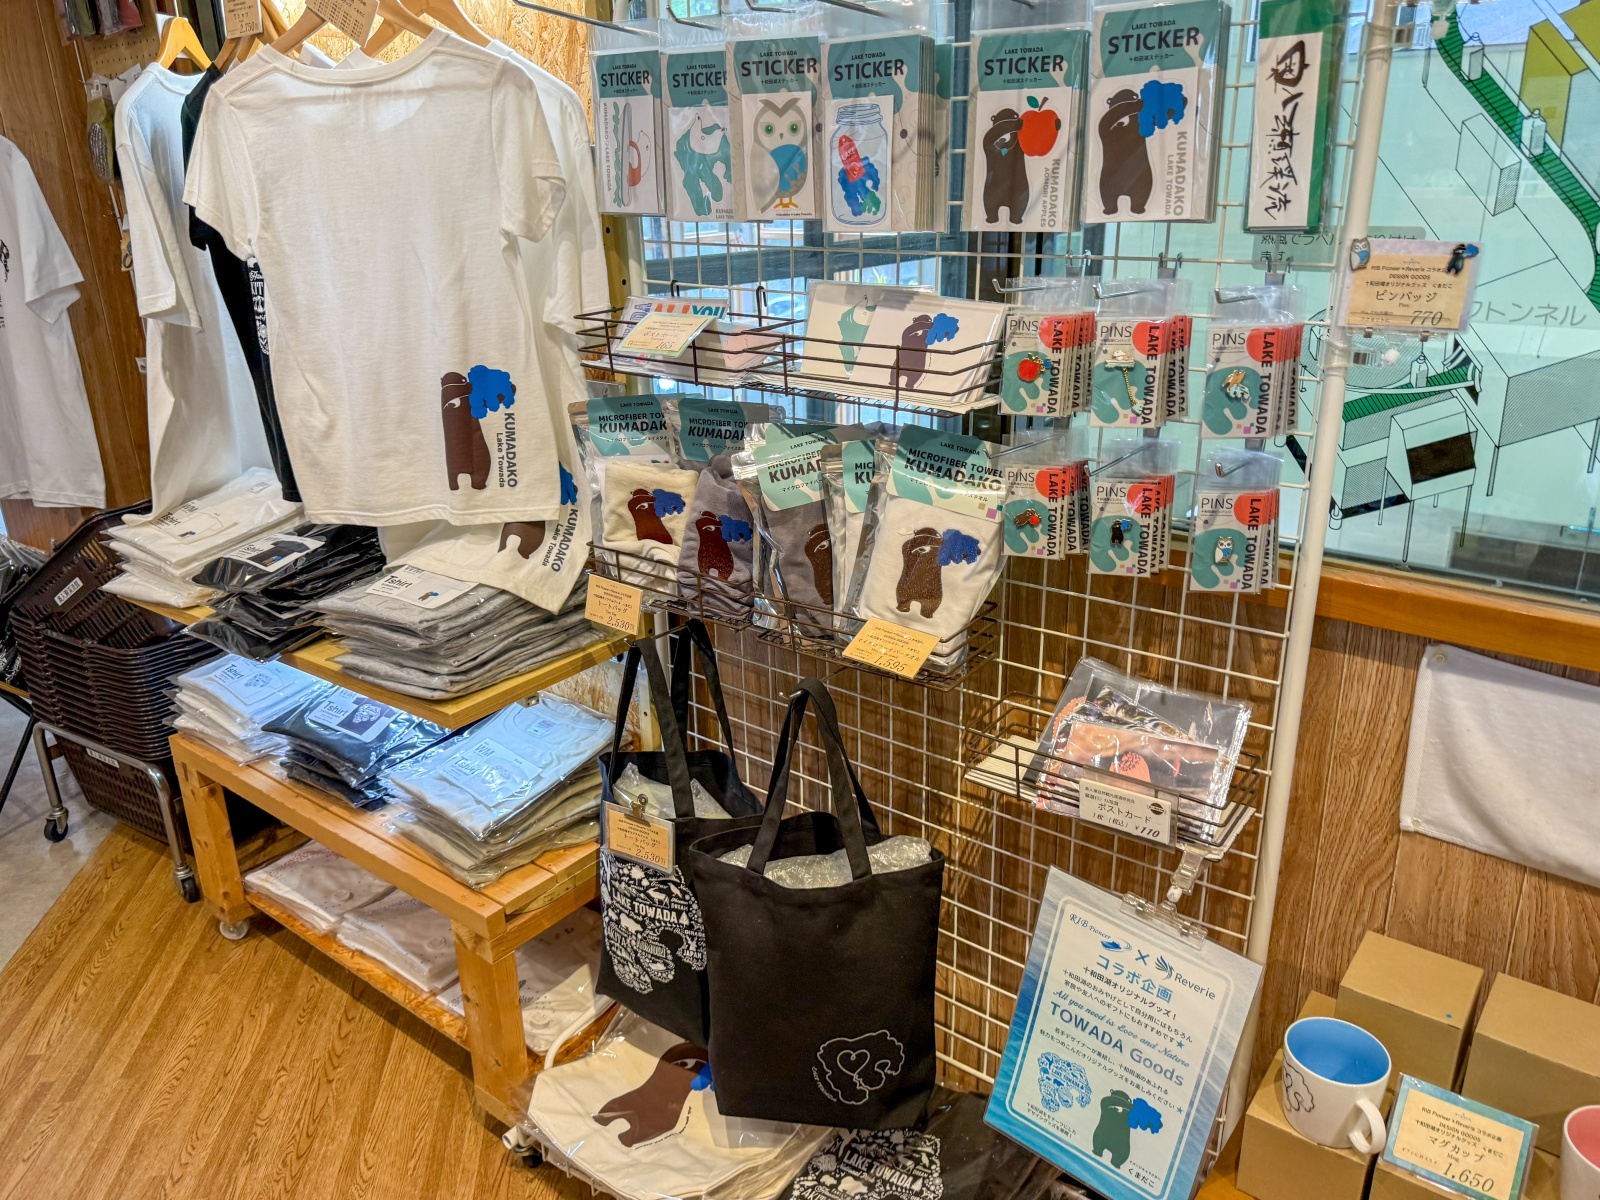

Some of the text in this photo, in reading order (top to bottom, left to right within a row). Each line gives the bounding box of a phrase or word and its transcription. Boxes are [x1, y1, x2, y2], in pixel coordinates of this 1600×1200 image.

[1132, 20, 1176, 30] LAKE TOWADA
[1108, 27, 1200, 54] STICKER
[741, 58, 817, 77] STICKER
[834, 59, 904, 82] STICKER
[984, 54, 1064, 76] STICKER
[601, 70, 650, 87] STICKER
[1173, 131, 1187, 216] KUMADAKO
[1049, 158, 1060, 228] KUMADAKO
[1164, 178, 1172, 216] TOWADA
[1376, 290, 1437, 303] ピンバッジ
[1010, 320, 1039, 332] PINS
[1411, 311, 1443, 326] 770
[1100, 326, 1132, 338] PINS
[1213, 333, 1246, 345] PINS
[656, 342, 675, 350] 165
[1047, 321, 1064, 414] LAKE TOWADA
[1141, 326, 1160, 425] LAKE TOWADA
[1255, 332, 1275, 434] LAKE TOWADA
[599, 413, 647, 422] MICROFIBER
[689, 418, 732, 428] MICROFIBER
[504, 412, 518, 488] KUMADAKO
[790, 437, 828, 450] LAKE TOWADA
[956, 446, 980, 456] TOWADA
[908, 448, 1003, 478] MICROFIBER TOWEL
[905, 458, 1002, 491] KUMADAKO
[1008, 472, 1035, 482] PINS
[1097, 486, 1126, 497] PINS
[1201, 498, 1233, 510] PINS
[161, 512, 181, 525] Tshirt
[1047, 474, 1058, 557] LAKE TOWADA
[1068, 501, 1077, 551] TOWADA
[1080, 496, 1090, 550] TOWADA
[551, 509, 578, 573] KUMADAKO
[1137, 488, 1152, 575] LAKE TOWADA
[542, 524, 564, 567] Lake Towada
[1242, 499, 1261, 590] LAKE TOWADA
[385, 576, 413, 588] Tshirt
[225, 664, 244, 679] Tshirt
[324, 701, 348, 716] Tshirt
[455, 756, 480, 775] Tshirt
[1098, 803, 1152, 824] ポストカード
[1135, 824, 1160, 838] ¥110
[613, 888, 678, 923] LAKE TOWADA
[1089, 925, 1111, 940] Pioneer
[1096, 954, 1174, 1004] コラボ企画
[1175, 974, 1216, 1000] Reverie
[1053, 990, 1190, 1068] All you need is Love and Nature
[1050, 1001, 1184, 1086] TOWADA Goods
[1432, 1110, 1451, 1121] Pioneer
[1456, 1120, 1476, 1131] Reverie
[1439, 1122, 1481, 1143] DESIGN GOODS
[1429, 1136, 1485, 1162] マグカップ
[1483, 1147, 1503, 1158] くまだこ
[844, 1150, 913, 1188] LAKE TOWADA
[1129, 1168, 1155, 1188] くまだこ
